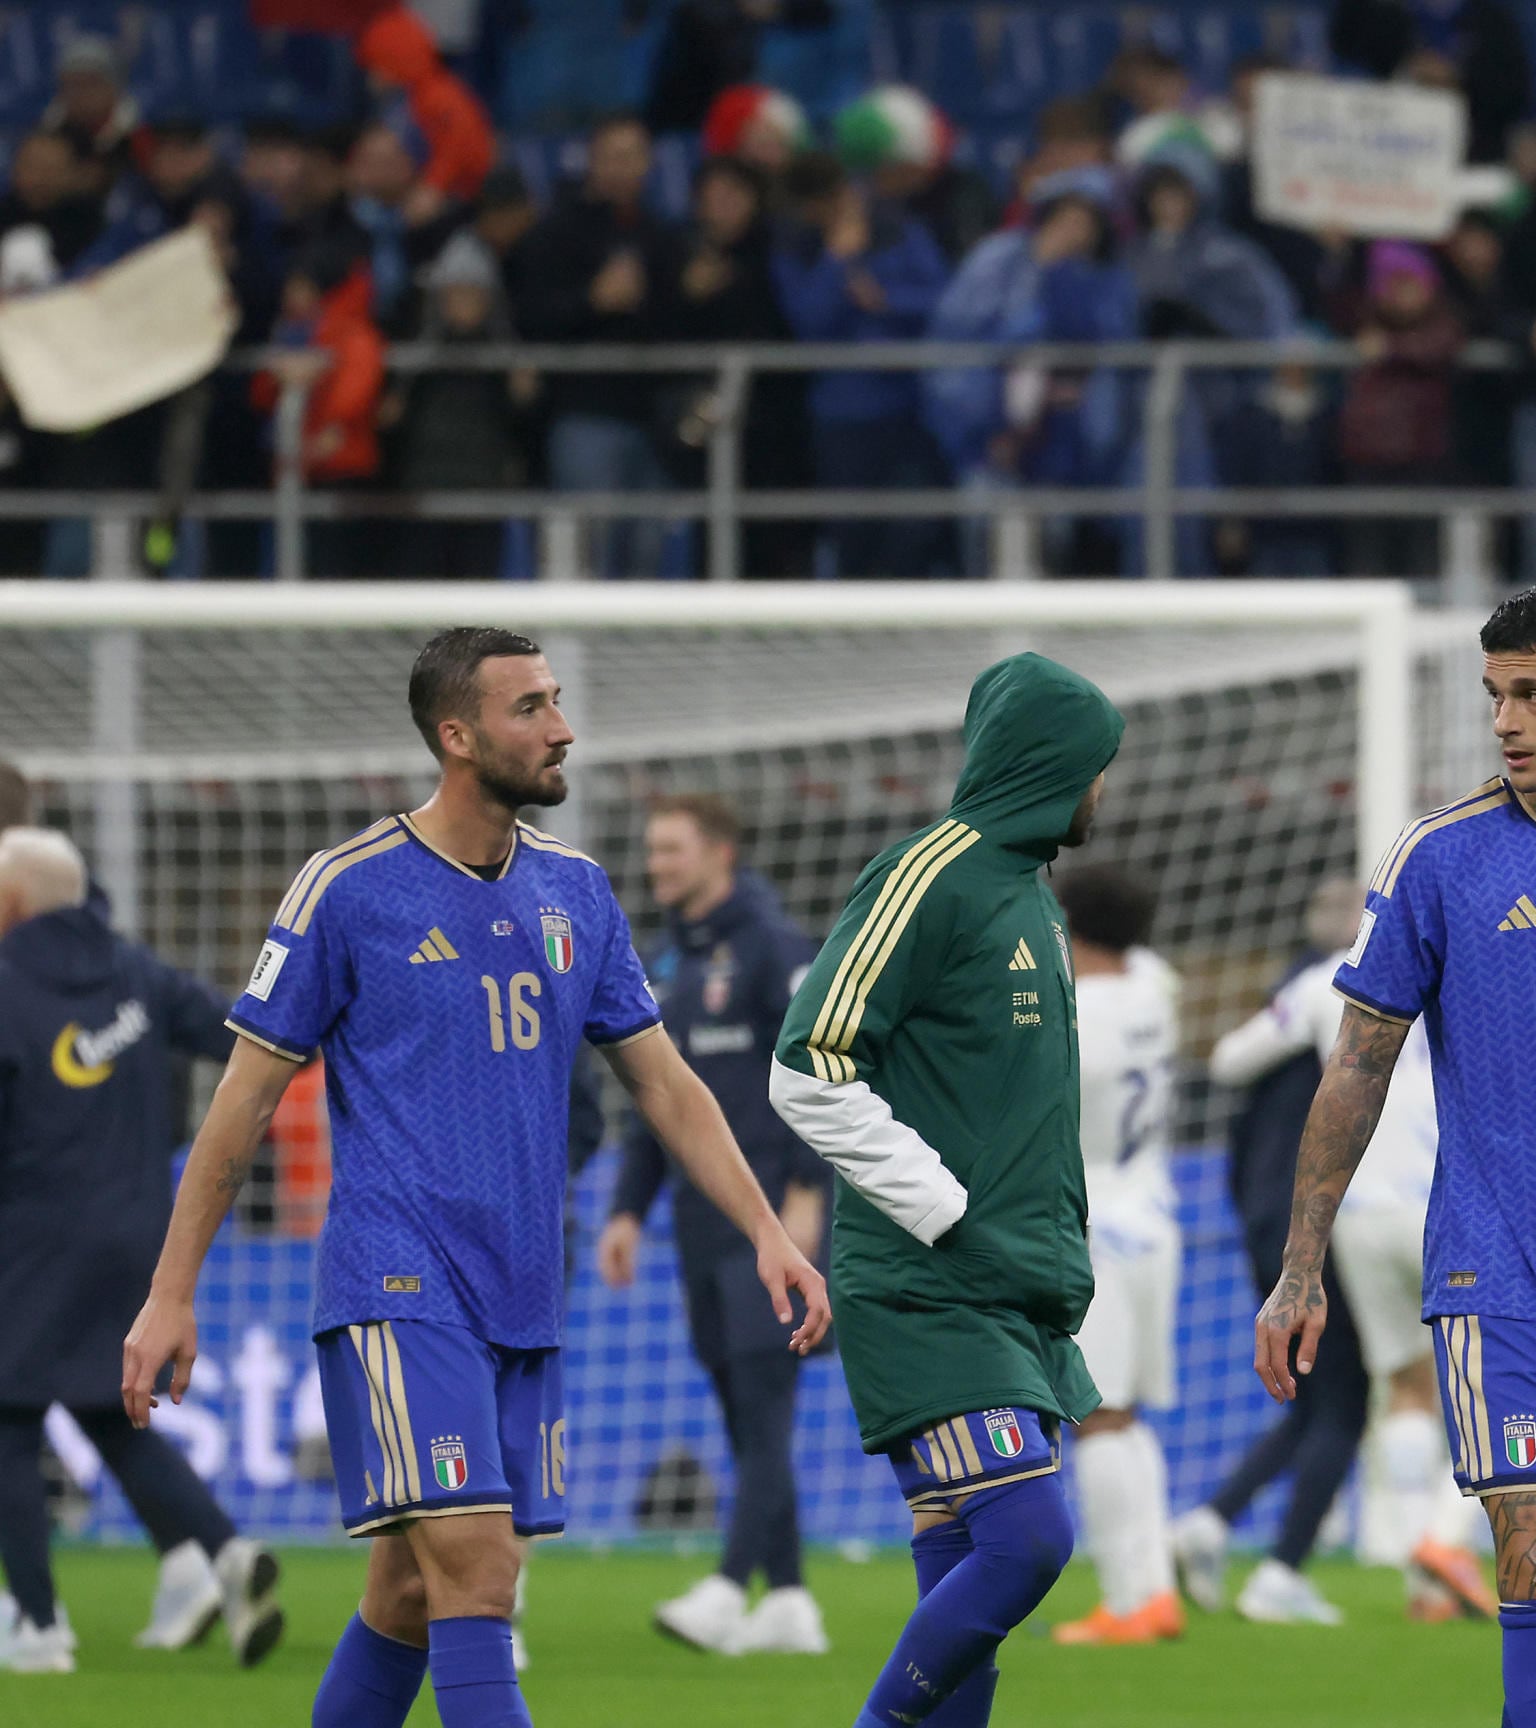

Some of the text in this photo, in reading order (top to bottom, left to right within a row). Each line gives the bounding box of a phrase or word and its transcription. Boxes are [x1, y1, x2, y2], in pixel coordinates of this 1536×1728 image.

[1022, 992, 1039, 1004] TIM
[481, 971, 542, 1053] 16
[1013, 1012, 1041, 1025] Poste
[988, 1414, 1014, 1429] ITALIA
[1506, 1425, 1534, 1436] ITALIA
[434, 1446, 462, 1459] ITALIA
